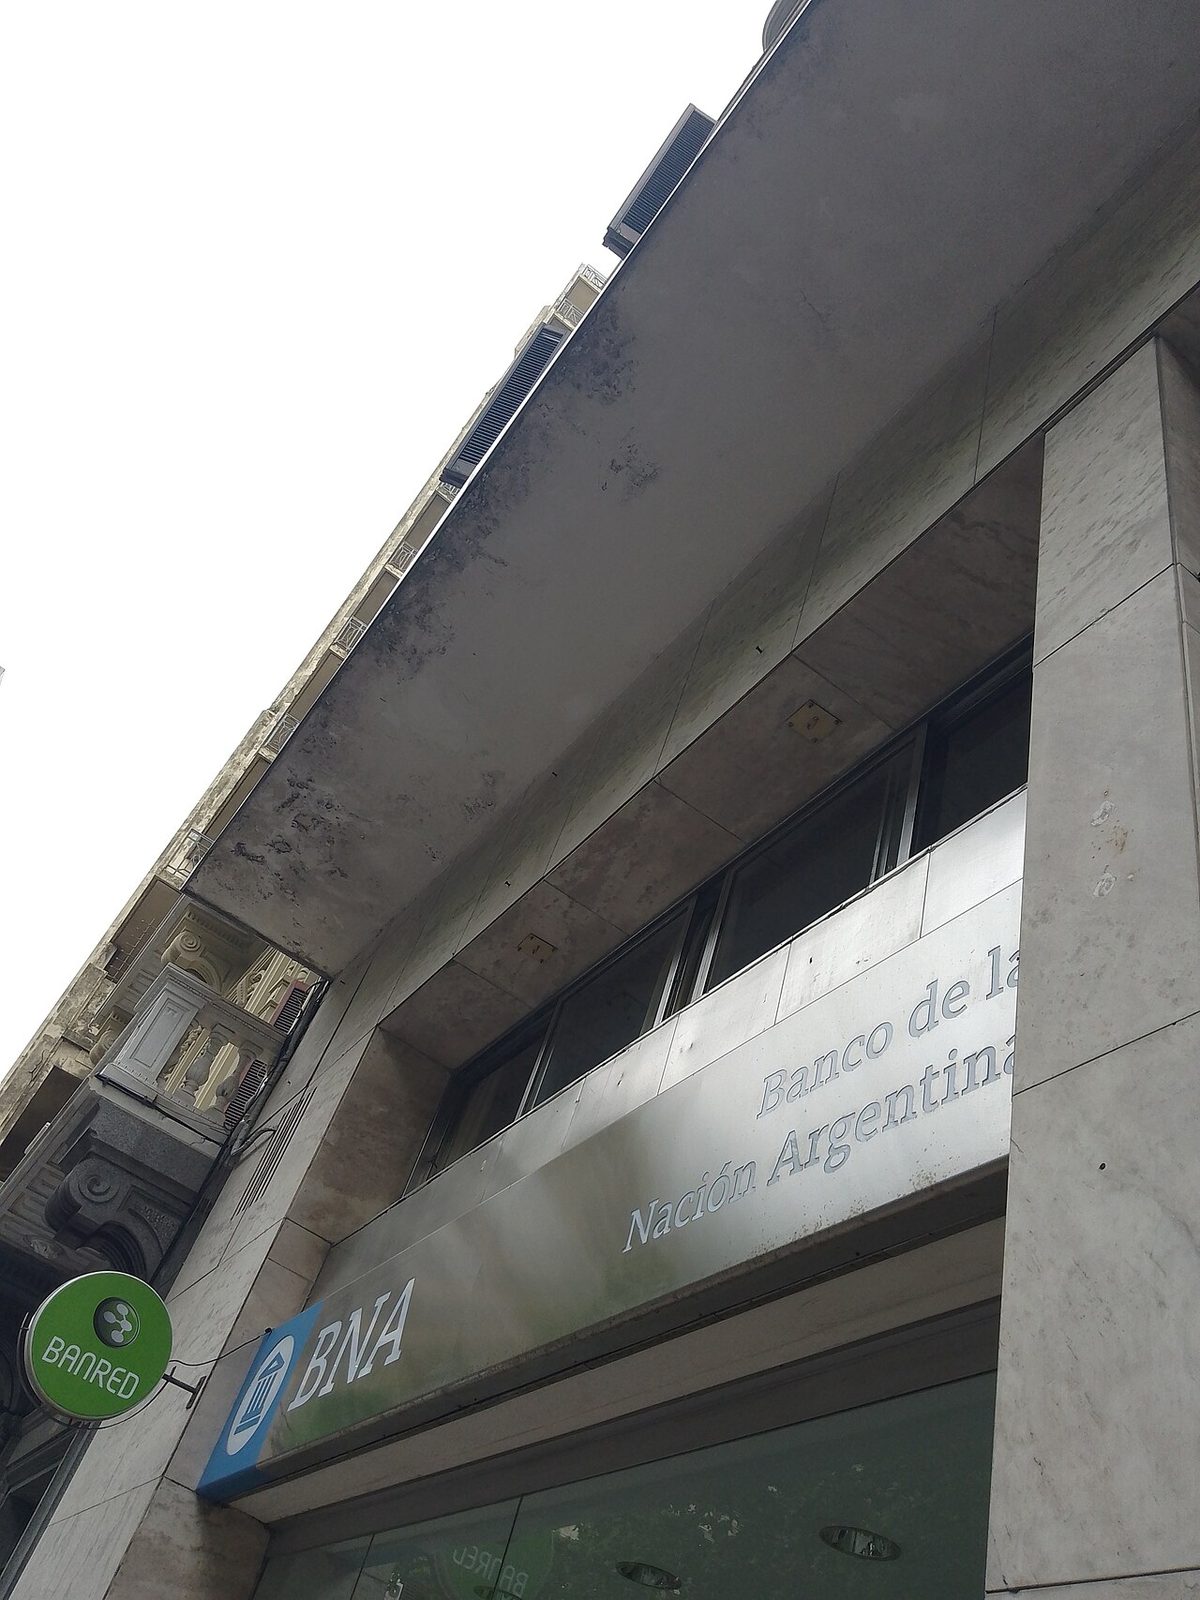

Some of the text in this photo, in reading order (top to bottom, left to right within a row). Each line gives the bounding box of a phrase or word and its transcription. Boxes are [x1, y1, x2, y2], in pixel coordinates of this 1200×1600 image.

[756, 1020, 893, 1119] Banco
[908, 978, 970, 1038] de
[622, 1159, 756, 1253] Nación
[41, 1336, 140, 1400] BANRED
[287, 1278, 416, 1412] BNA
